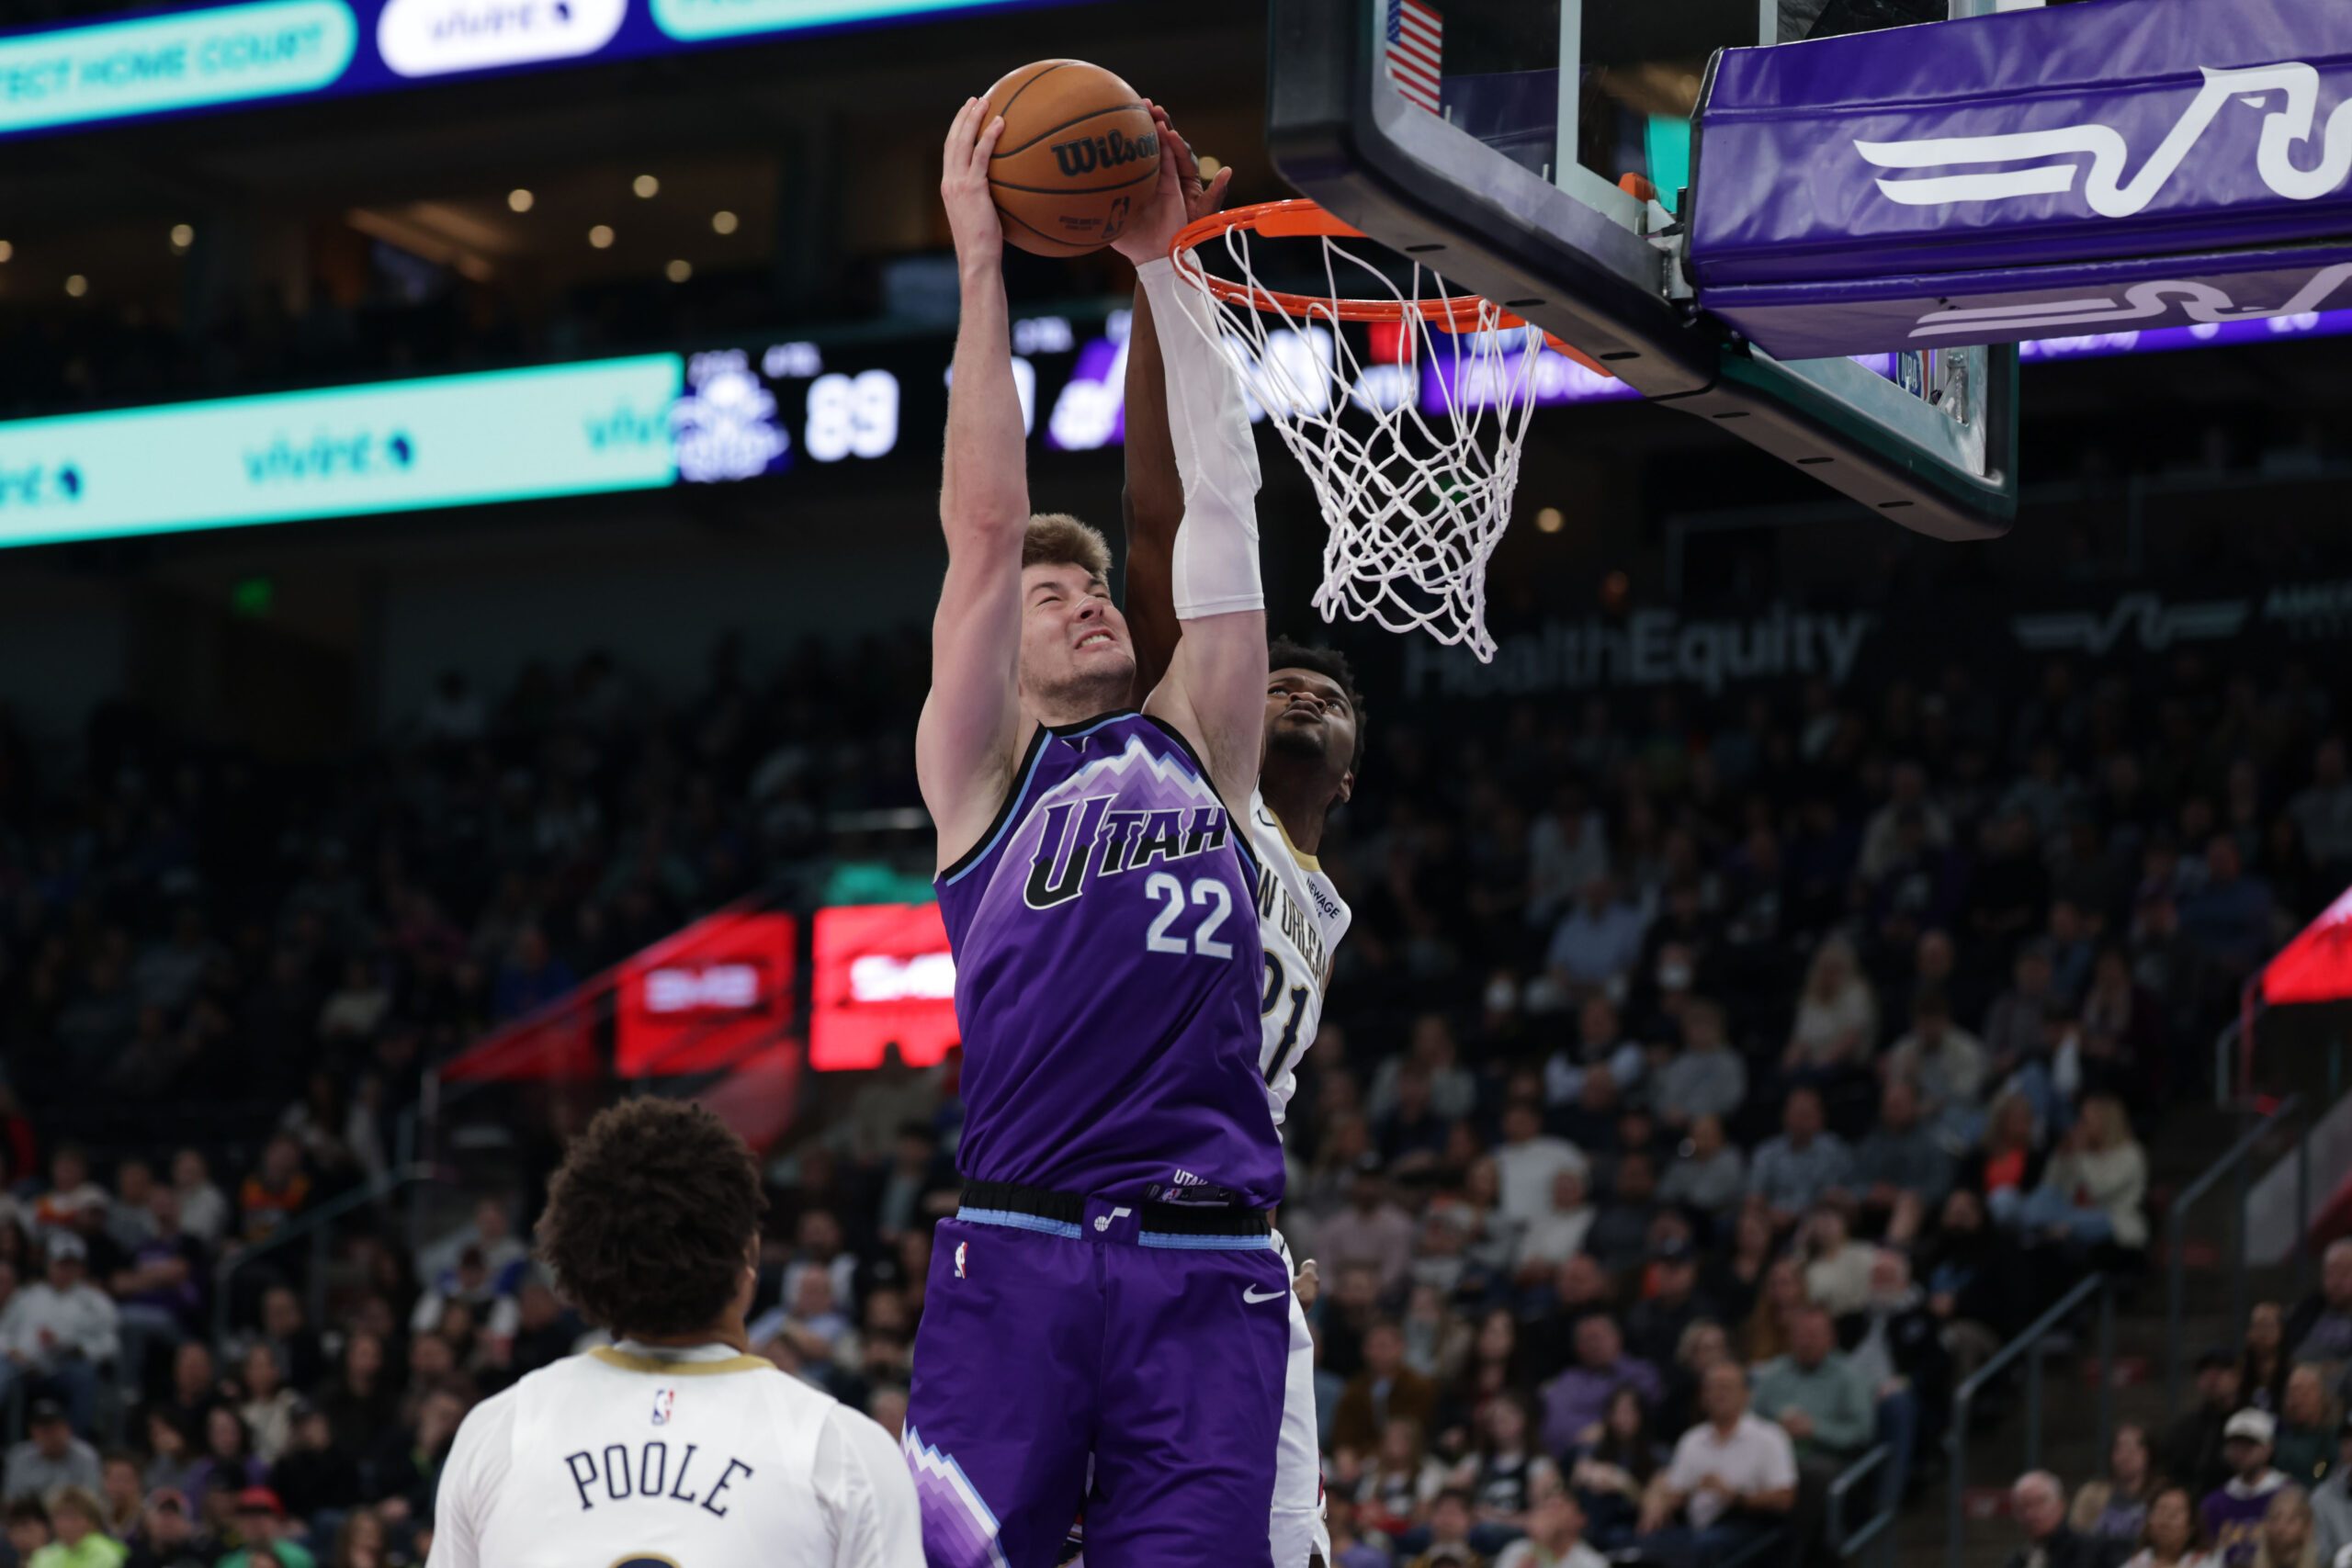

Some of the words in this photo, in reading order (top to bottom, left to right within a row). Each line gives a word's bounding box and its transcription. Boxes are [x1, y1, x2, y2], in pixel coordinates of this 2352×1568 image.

[81, 47, 187, 87] HOME
[198, 22, 325, 76] COURT
[1051, 129, 1159, 176] Wilson
[806, 369, 899, 461] 89
[1023, 793, 1229, 909] UTAH
[1145, 872, 1233, 960] 22
[1306, 877, 1340, 919] NEWAGE
[564, 1441, 753, 1518] POOLE
